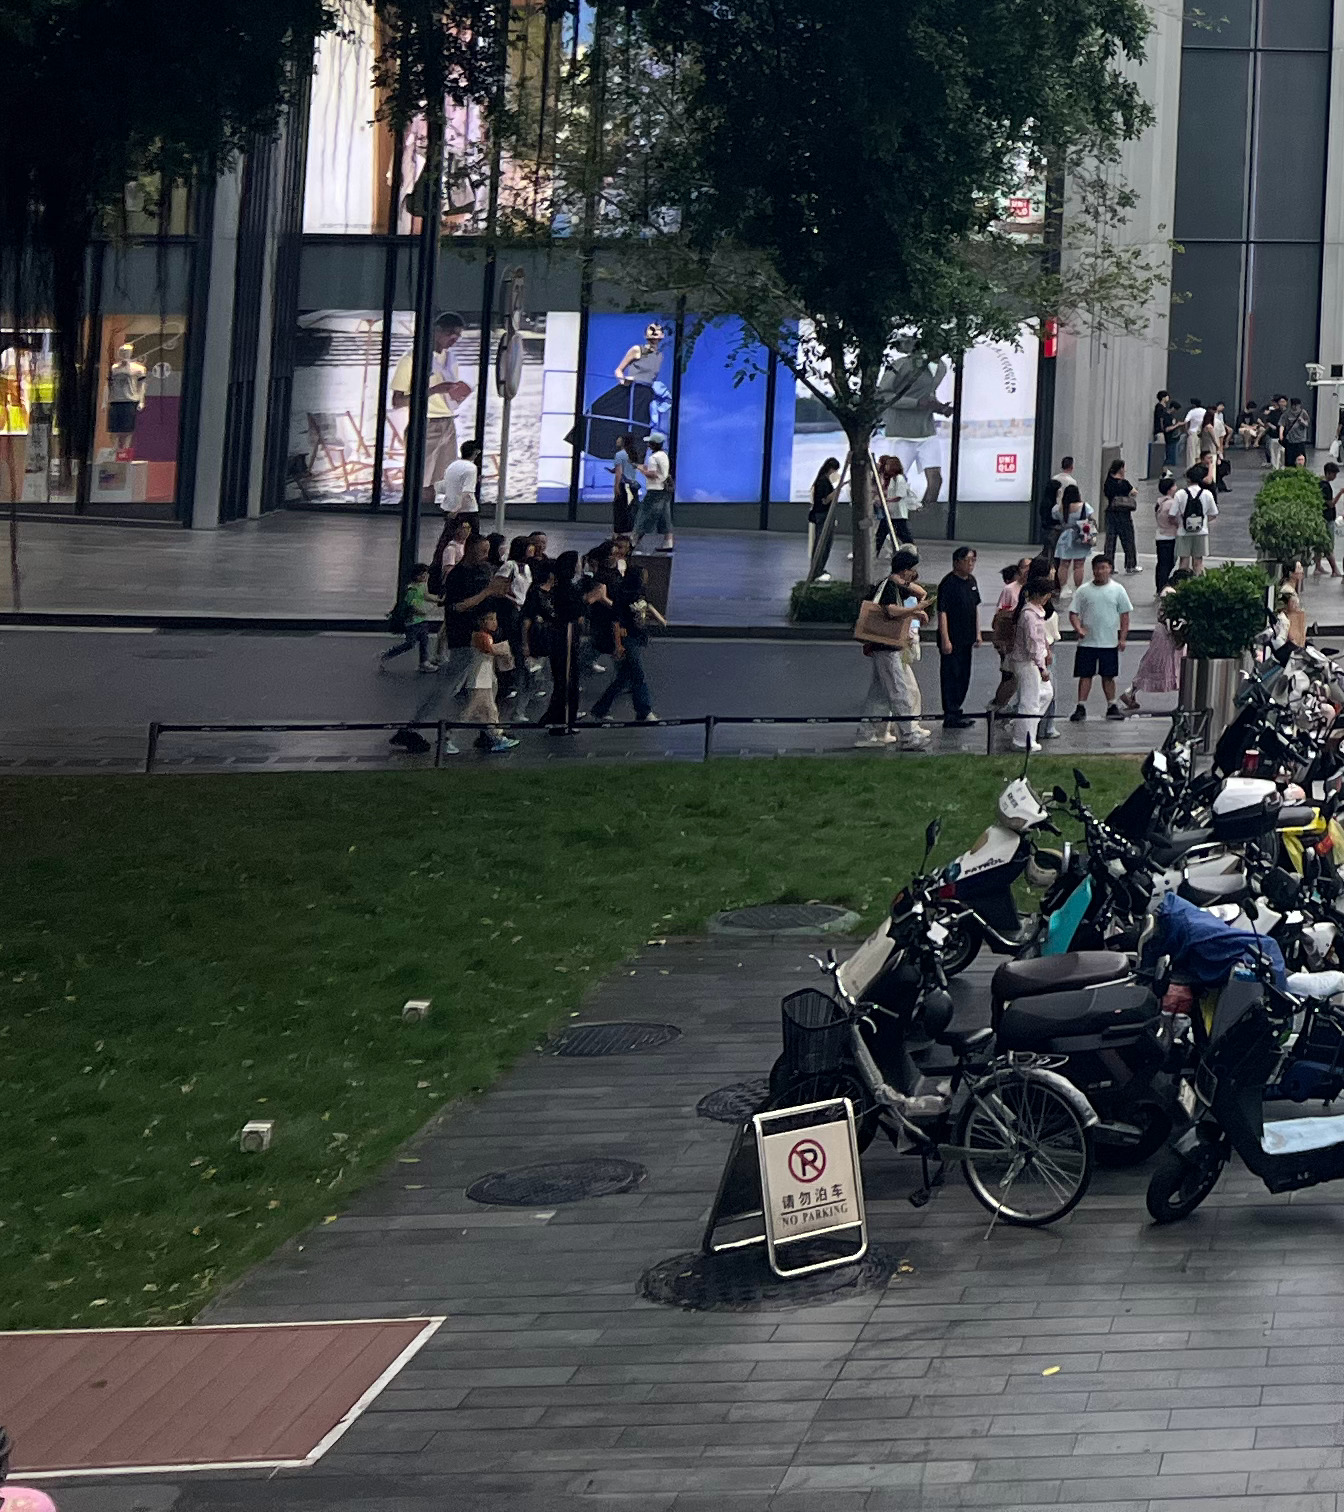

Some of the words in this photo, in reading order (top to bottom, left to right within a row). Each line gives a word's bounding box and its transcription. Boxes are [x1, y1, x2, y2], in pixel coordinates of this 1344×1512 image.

[964, 857, 1005, 875] PATROL
[781, 1183, 844, 1210] 请勿泊车
[782, 1213, 799, 1228] NO
[802, 1202, 849, 1225] PARKING
